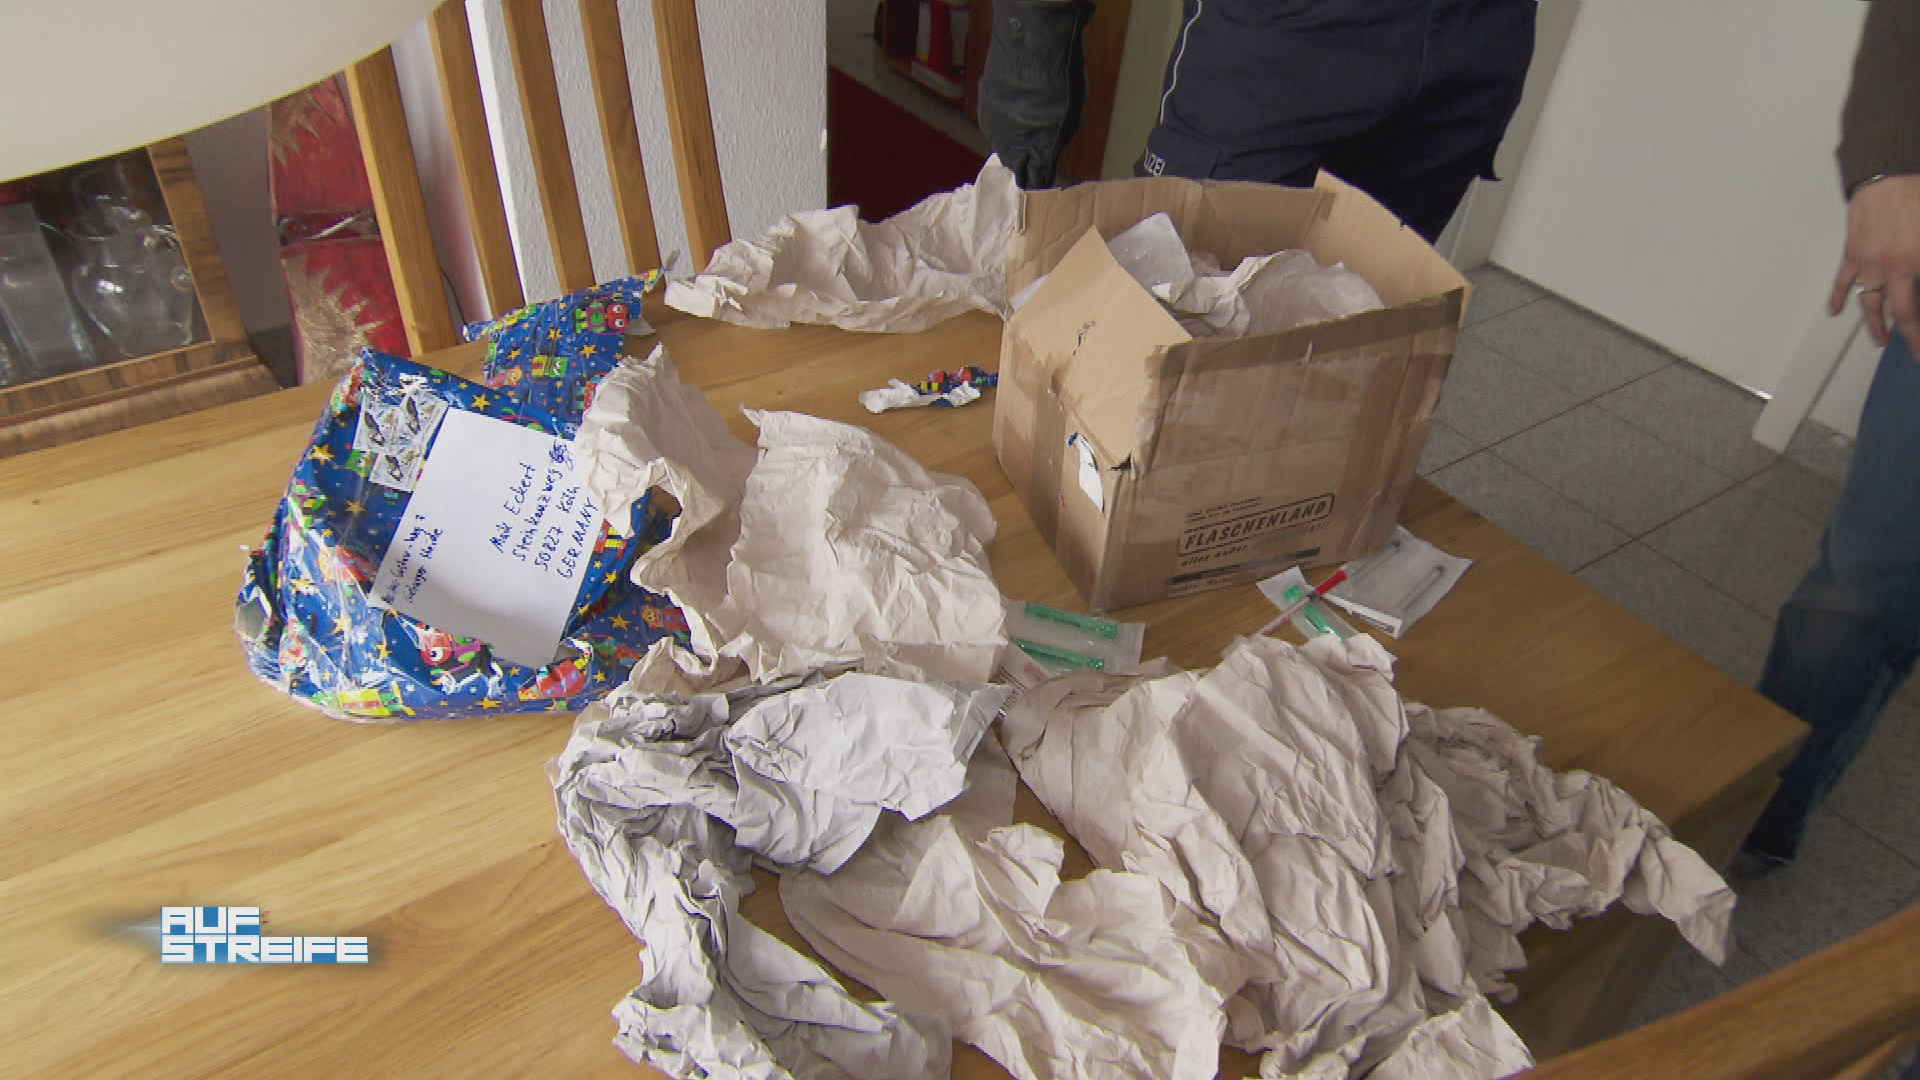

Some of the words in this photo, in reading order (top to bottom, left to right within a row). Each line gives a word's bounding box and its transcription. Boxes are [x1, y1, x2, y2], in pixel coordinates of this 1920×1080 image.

[503, 462, 535, 515] Eckert
[534, 526, 563, 571] 50827
[556, 496, 598, 578] GERMANY
[1184, 500, 1327, 550] FLASCHENLAND
